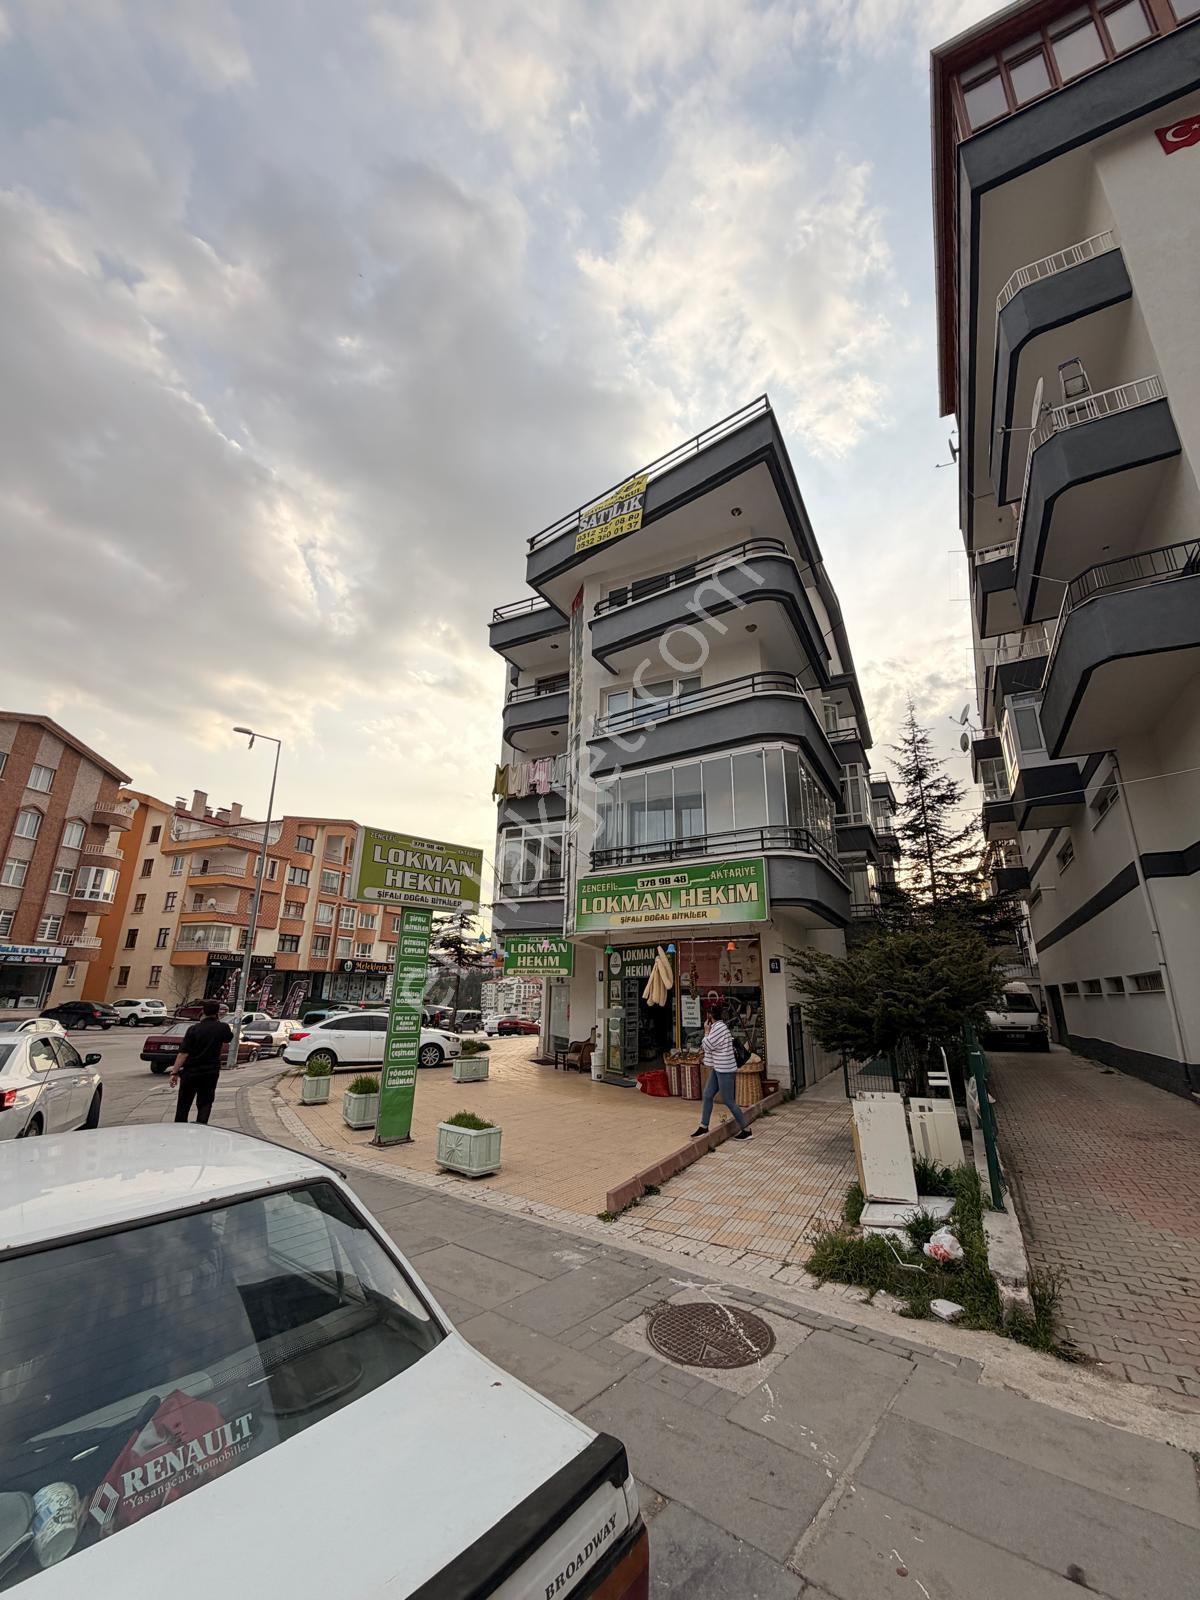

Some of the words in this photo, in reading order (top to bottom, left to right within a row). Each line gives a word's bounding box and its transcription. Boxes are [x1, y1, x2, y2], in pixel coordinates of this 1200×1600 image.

[579, 493, 644, 533] SATILIK
[373, 843, 475, 878] LOKMAN
[638, 879, 656, 888] 378
[657, 877, 671, 886] 98
[673, 875, 687, 884] 48
[710, 866, 756, 880] AKTARİYE
[580, 889, 672, 915] LOKMAN
[620, 914, 643, 925] ŞİFALI
[644, 912, 670, 923] DOĞAL
[671, 910, 708, 922] BİTKİLER
[510, 943, 568, 954] LOKMAN
[622, 947, 655, 962] LOKMAN
[121, 1412, 253, 1499] RENAULT
[544, 1512, 617, 1600] BROADWAY
